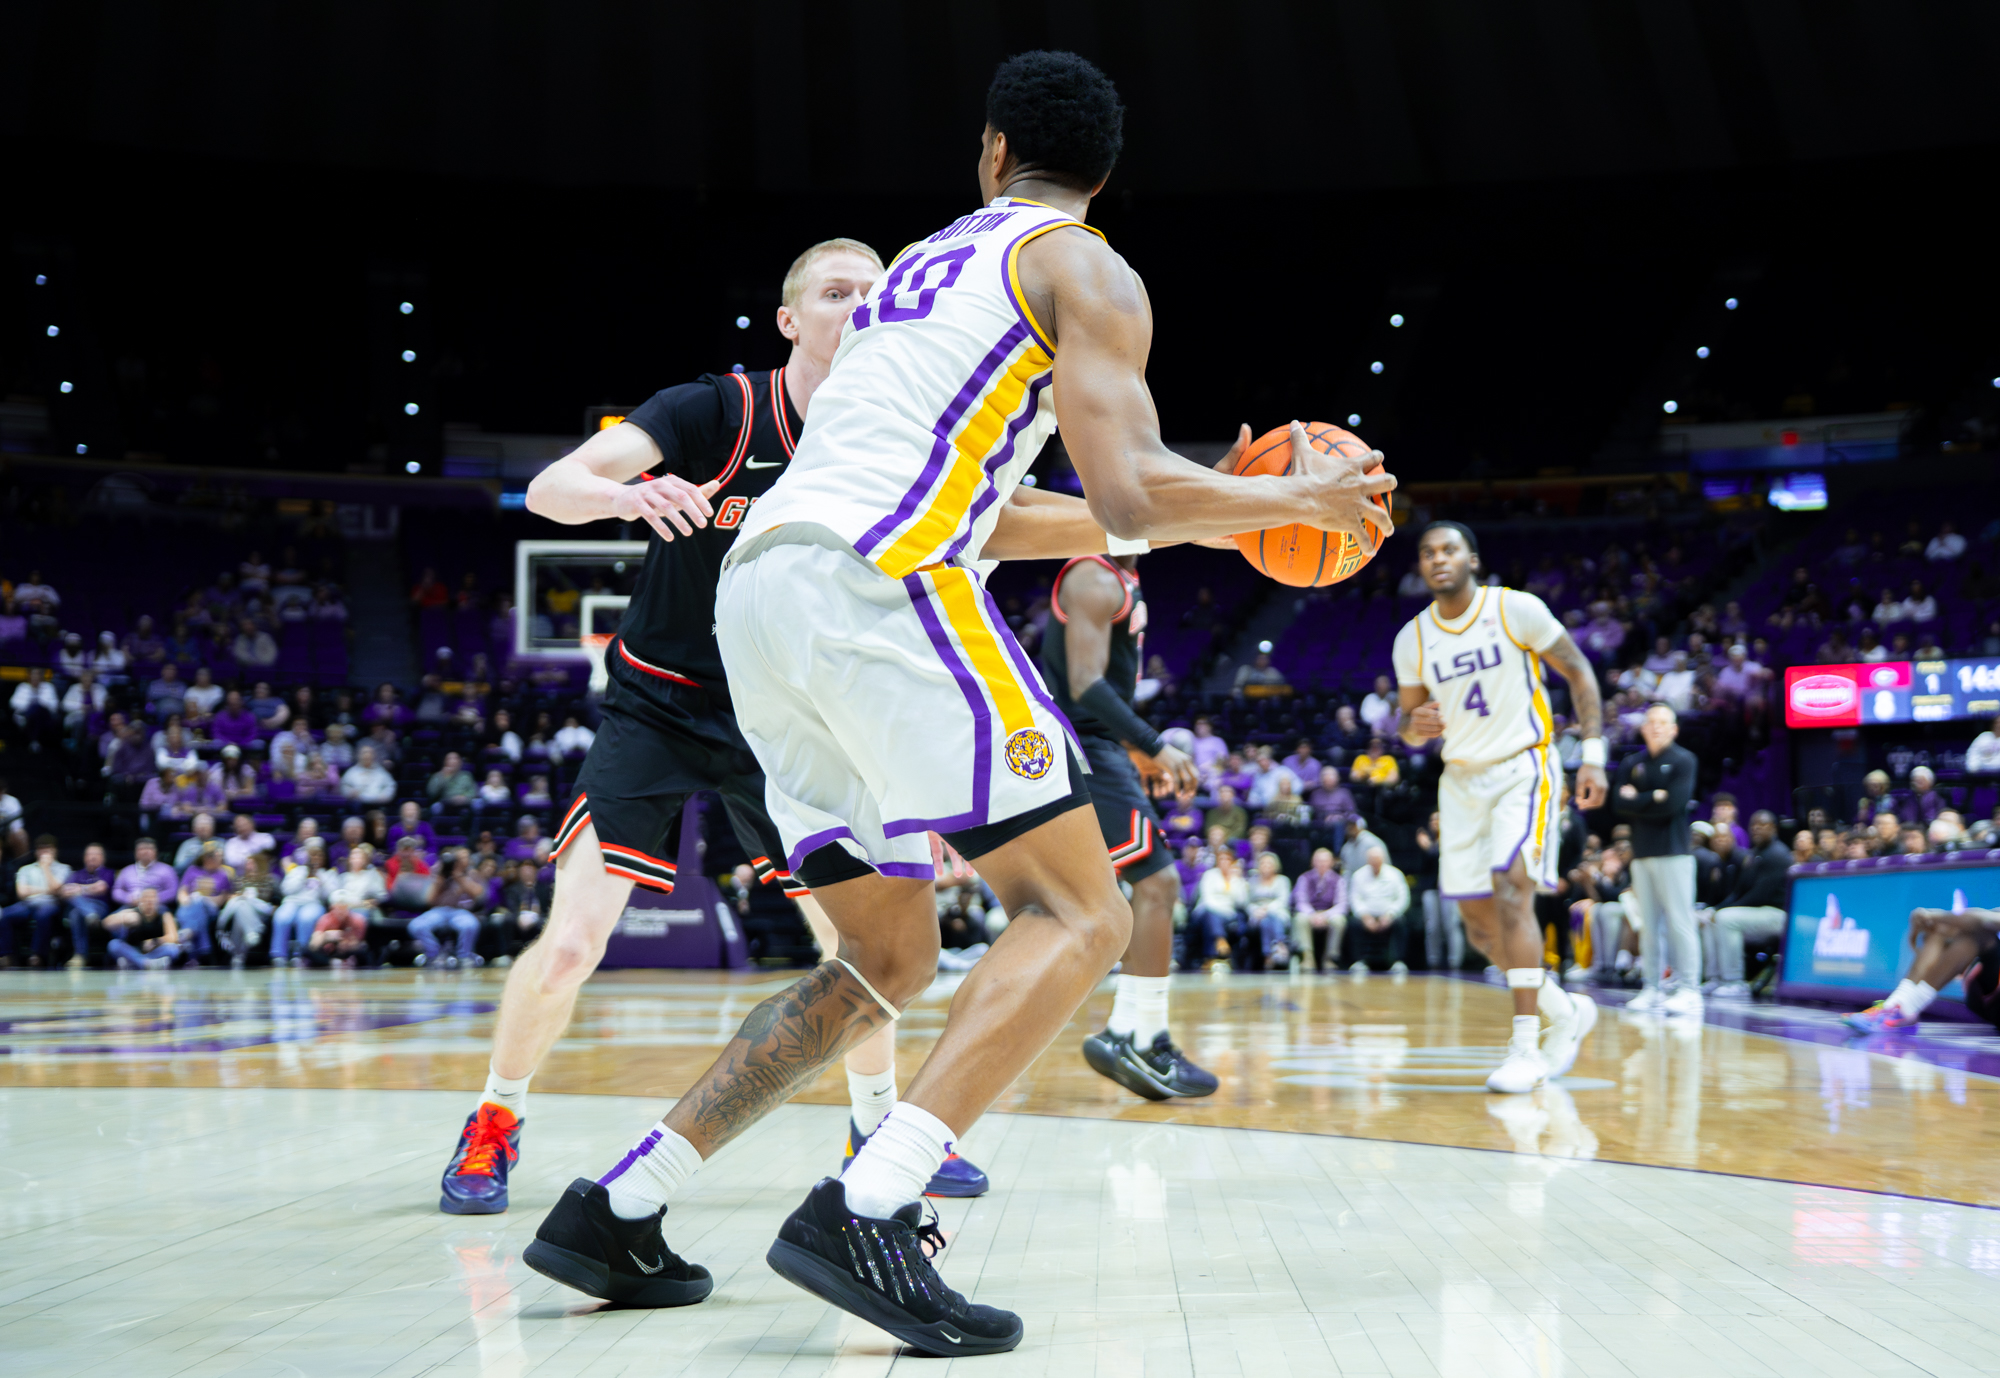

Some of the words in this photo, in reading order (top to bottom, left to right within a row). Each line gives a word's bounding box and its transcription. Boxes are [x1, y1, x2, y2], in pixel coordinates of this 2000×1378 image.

[852, 244, 977, 331] 10
[1432, 644, 1502, 684] LSU
[1464, 681, 1490, 717] 4
